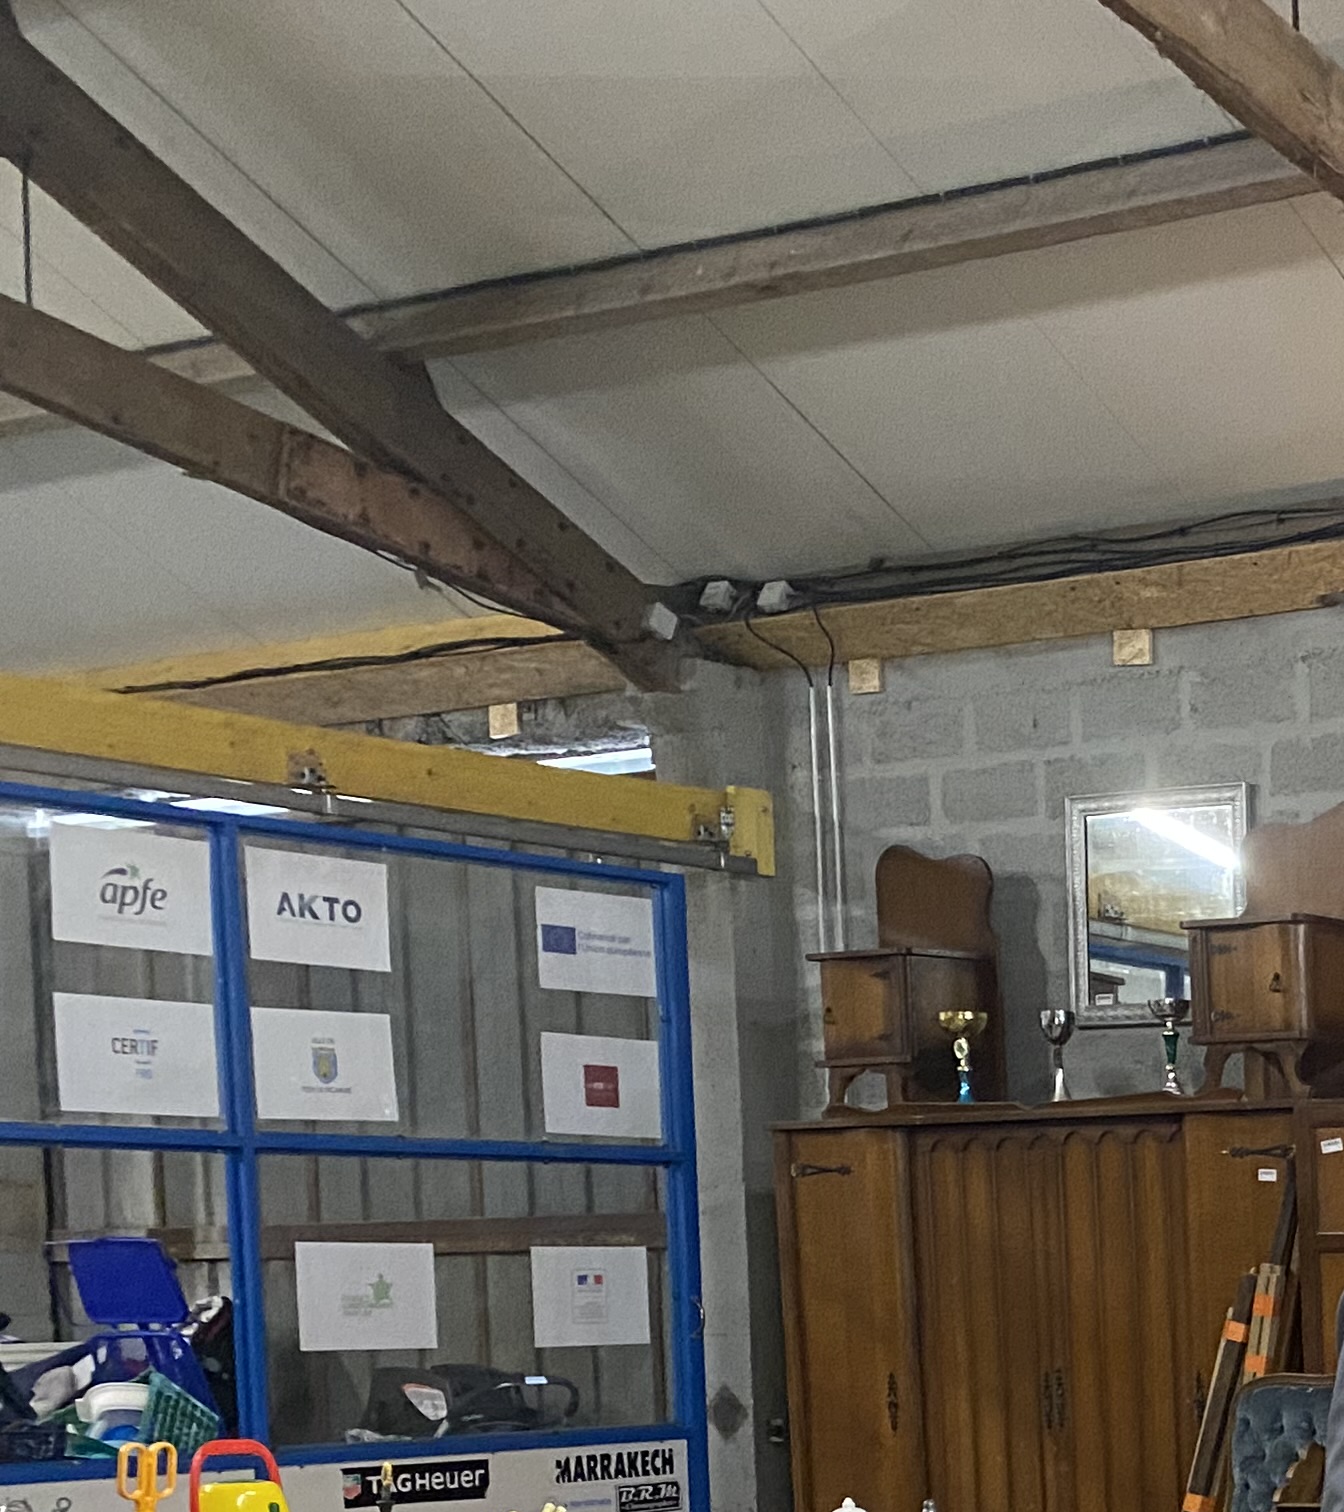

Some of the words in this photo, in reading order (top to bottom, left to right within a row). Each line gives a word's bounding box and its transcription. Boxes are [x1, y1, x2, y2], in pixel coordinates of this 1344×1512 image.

[99, 878, 168, 915] apfe
[276, 891, 362, 924] AKTO
[111, 1037, 159, 1056] CERTIF
[555, 1448, 675, 1484] MARRAKECH
